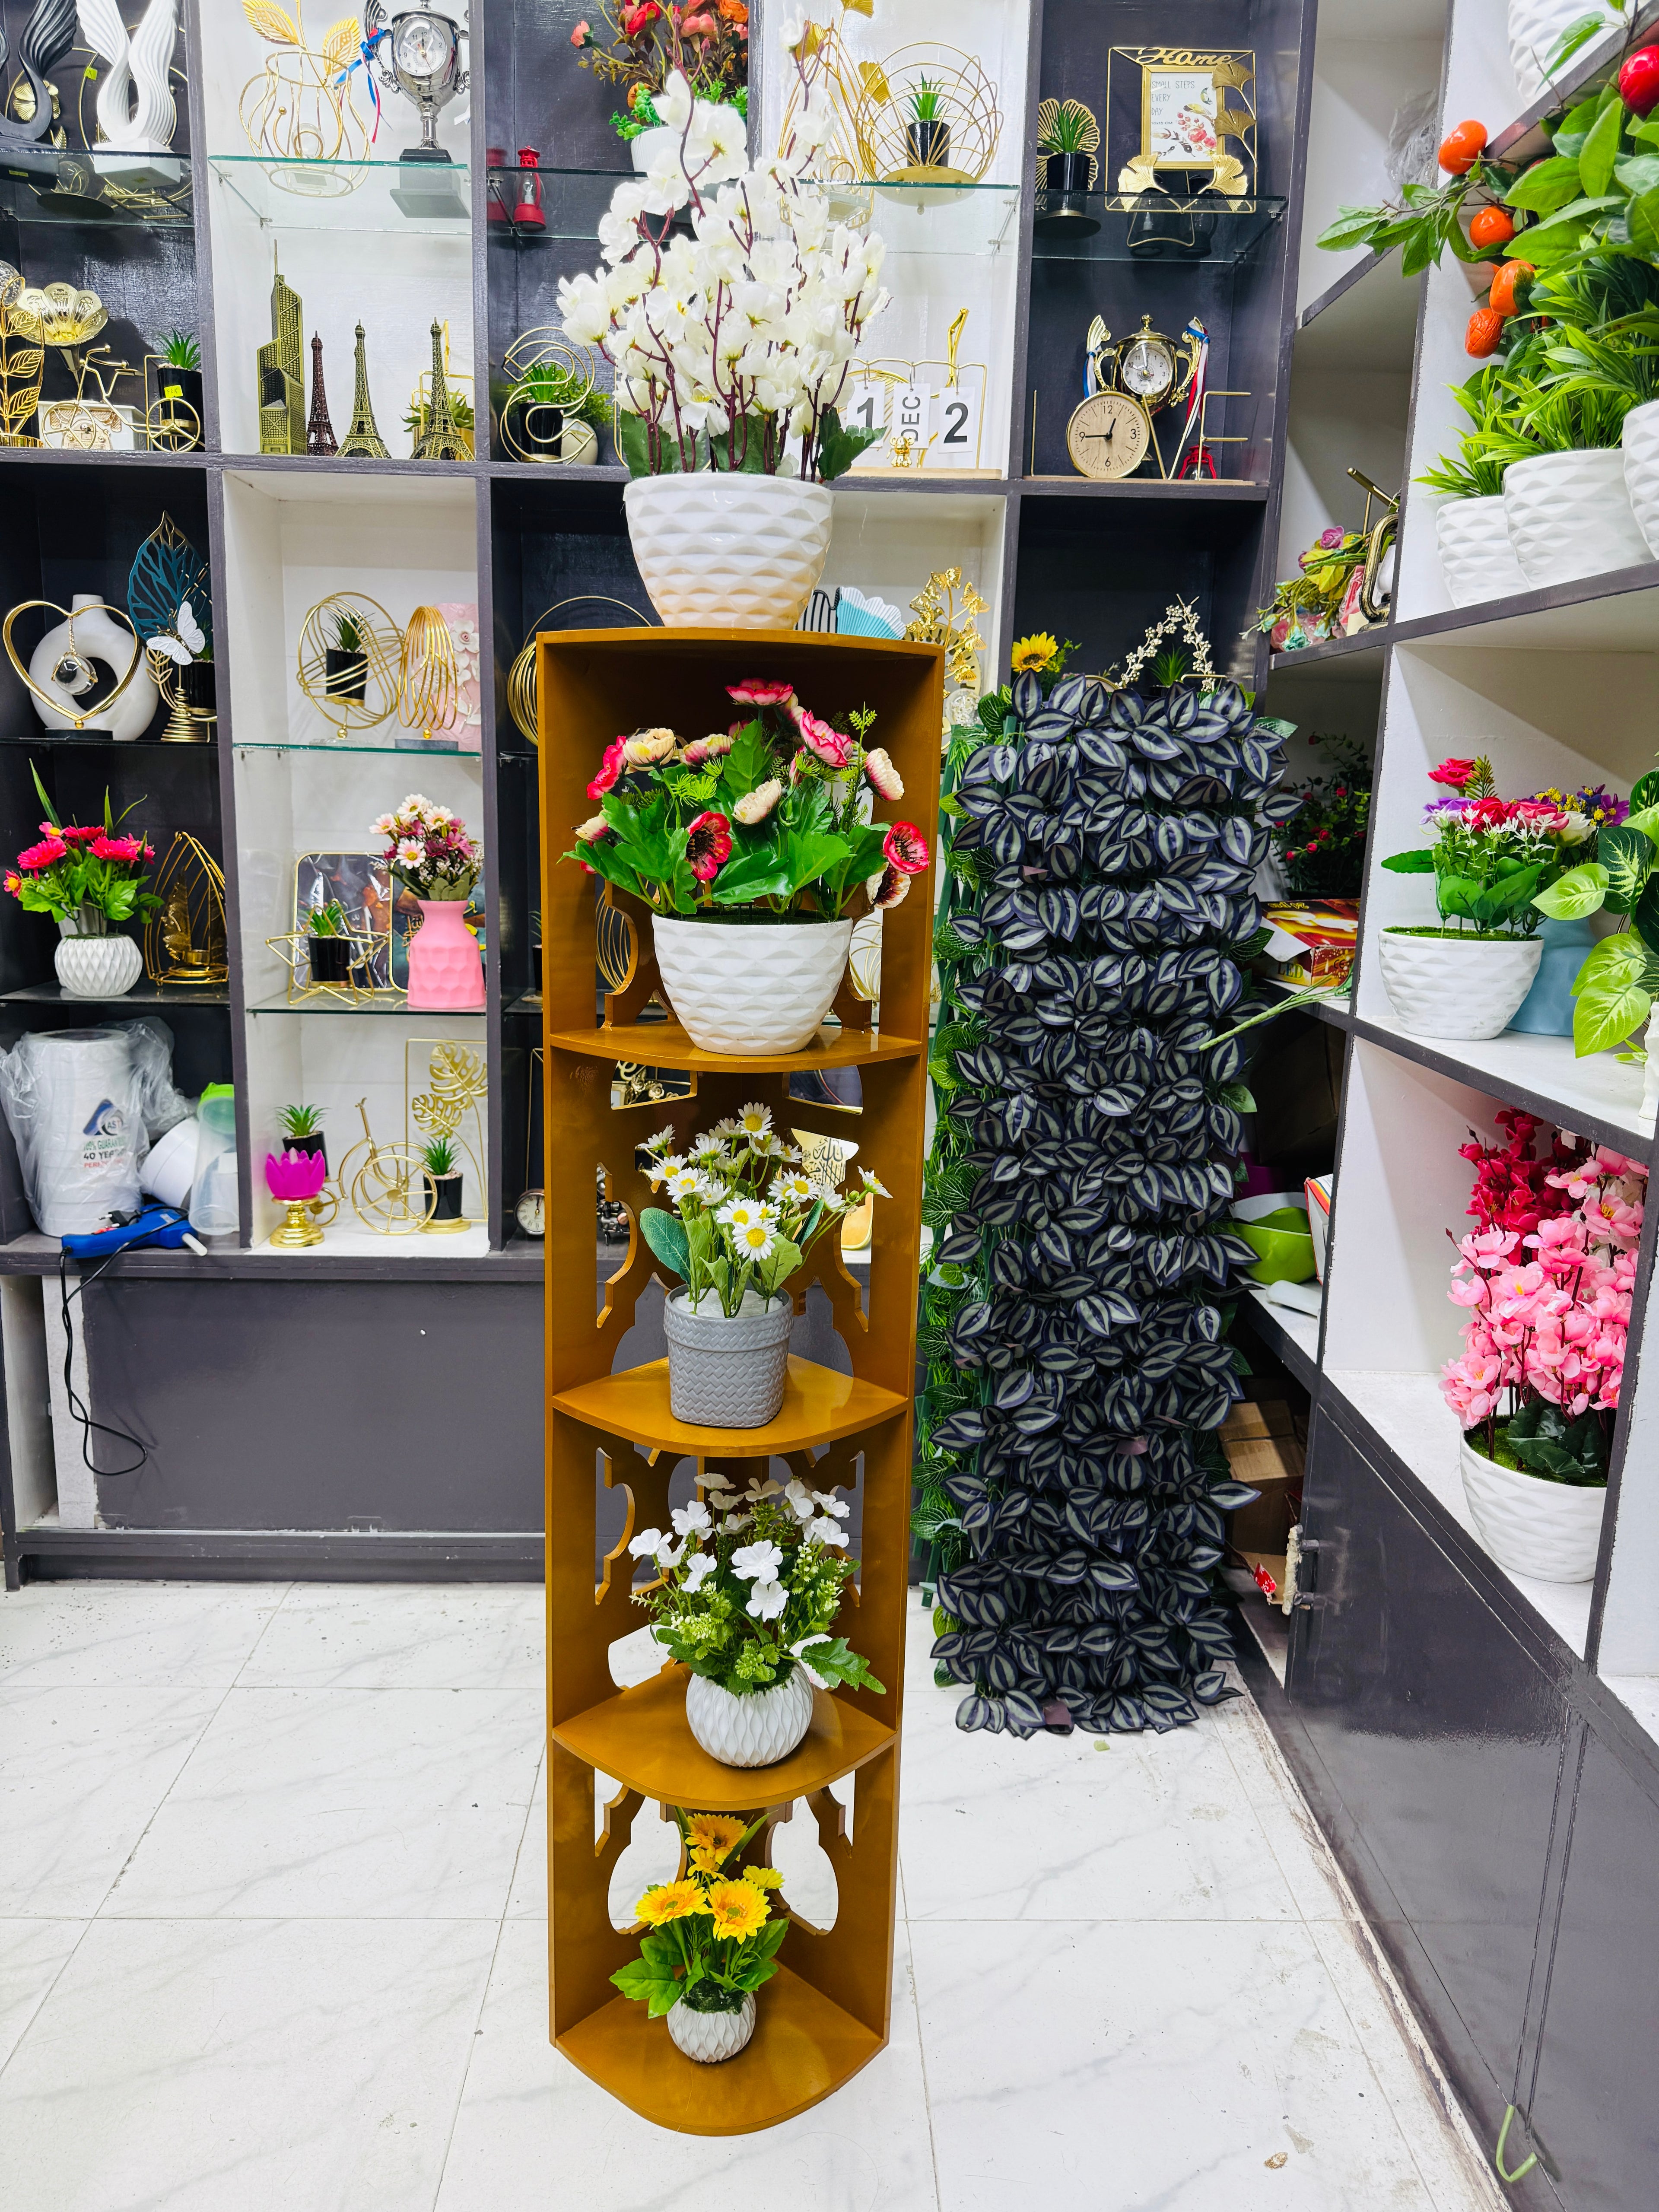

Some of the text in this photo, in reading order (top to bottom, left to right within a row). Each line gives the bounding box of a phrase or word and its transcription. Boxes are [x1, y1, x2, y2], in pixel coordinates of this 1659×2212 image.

[1136, 47, 1232, 66] Home
[1152, 80, 1195, 89] SMALL STEPS
[1151, 93, 1171, 102] EVERY
[1151, 108, 1163, 116] DAY
[1103, 405, 1112, 414] 12
[944, 402, 969, 444] 2
[1079, 432, 1085, 442] 9
[1130, 429, 1137, 439] 3
[1105, 457, 1111, 467] 6
